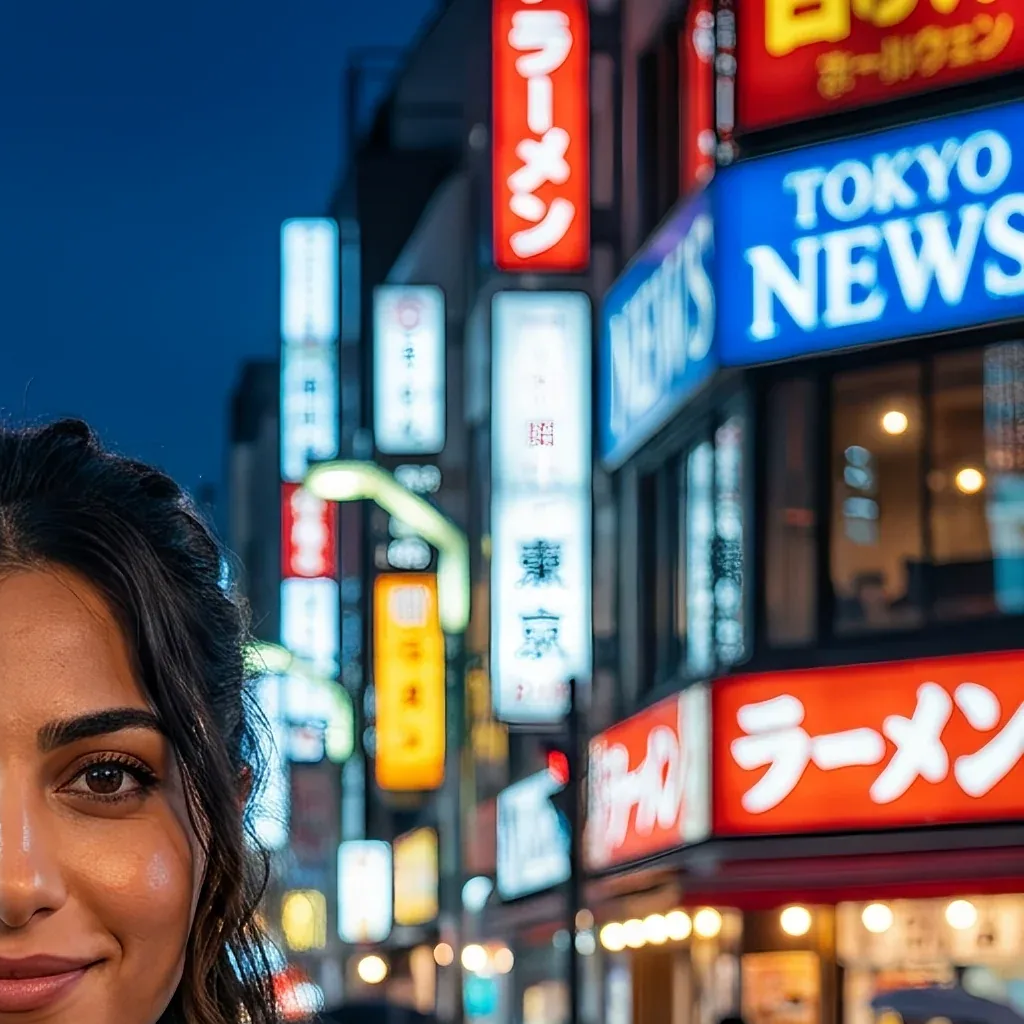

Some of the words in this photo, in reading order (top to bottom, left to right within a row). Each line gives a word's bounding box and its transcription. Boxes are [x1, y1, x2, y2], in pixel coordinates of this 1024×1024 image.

[507, 6, 576, 259] ラーメン
[784, 130, 1012, 229] TOKYO
[744, 193, 1024, 342] NEWS
[730, 681, 1024, 814] ラーメン
